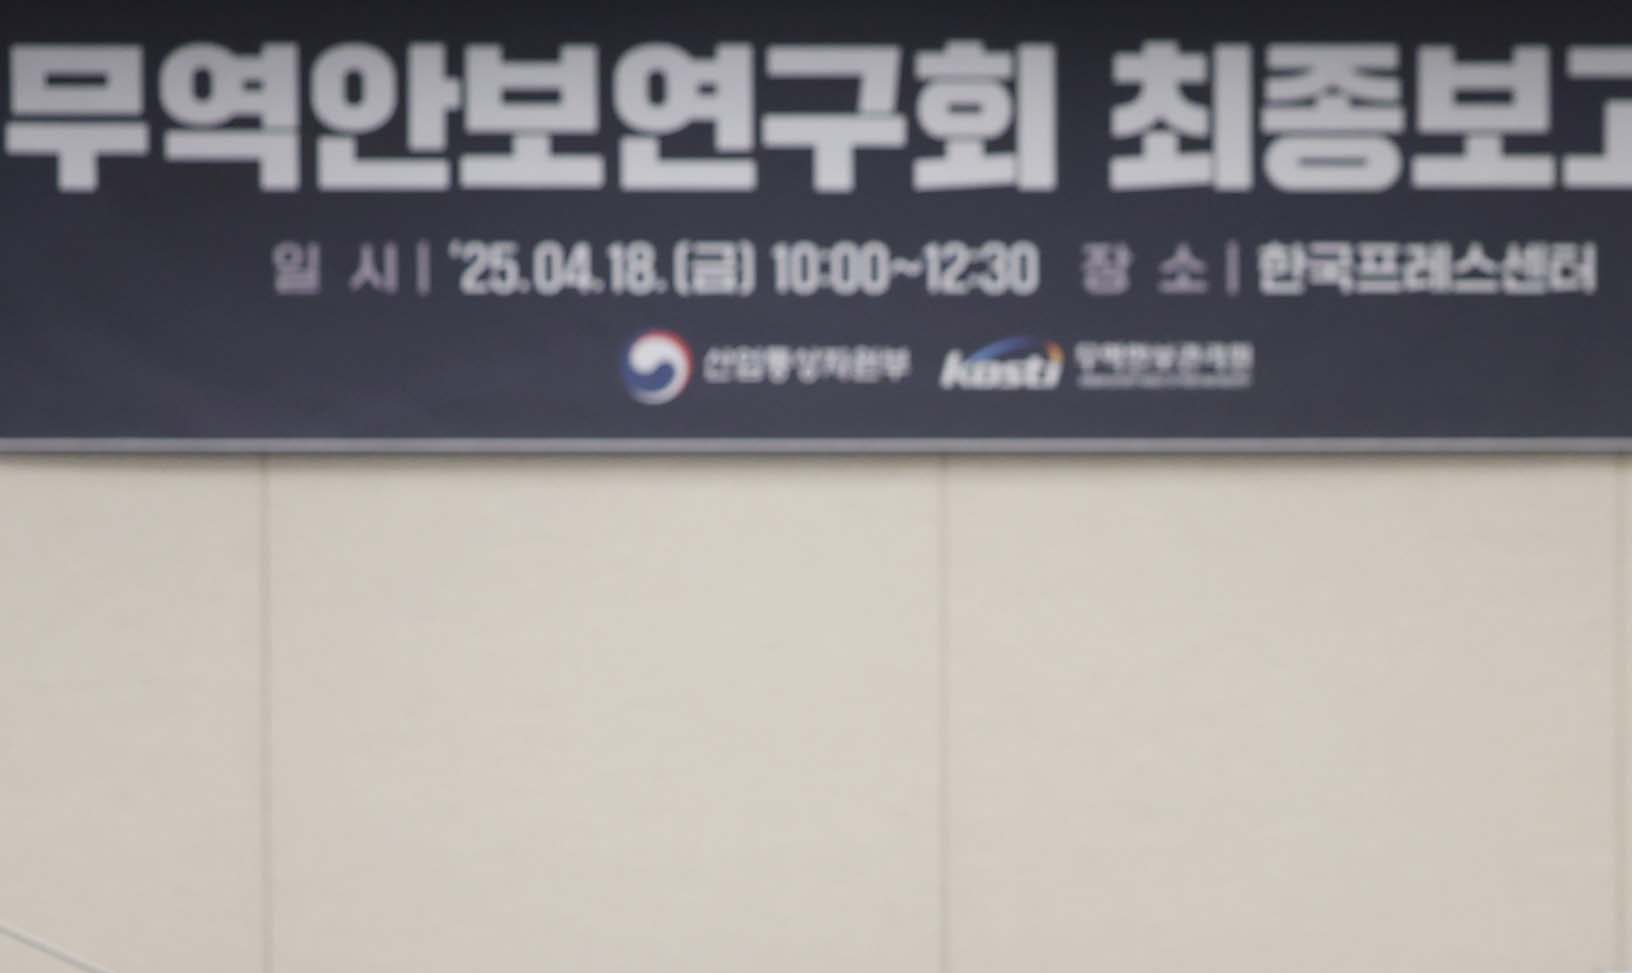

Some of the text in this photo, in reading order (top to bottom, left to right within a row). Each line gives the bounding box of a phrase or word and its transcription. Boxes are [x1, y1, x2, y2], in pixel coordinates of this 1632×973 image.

[4, 39, 1059, 194] 무역안보연구회
[271, 241, 321, 295] 일
[349, 241, 399, 295] 시
[771, 239, 1041, 297] 10:00~12:30
[1082, 241, 1133, 295] 장
[1158, 242, 1208, 295] 소
[1257, 240, 1597, 296] 한국프레스센터
